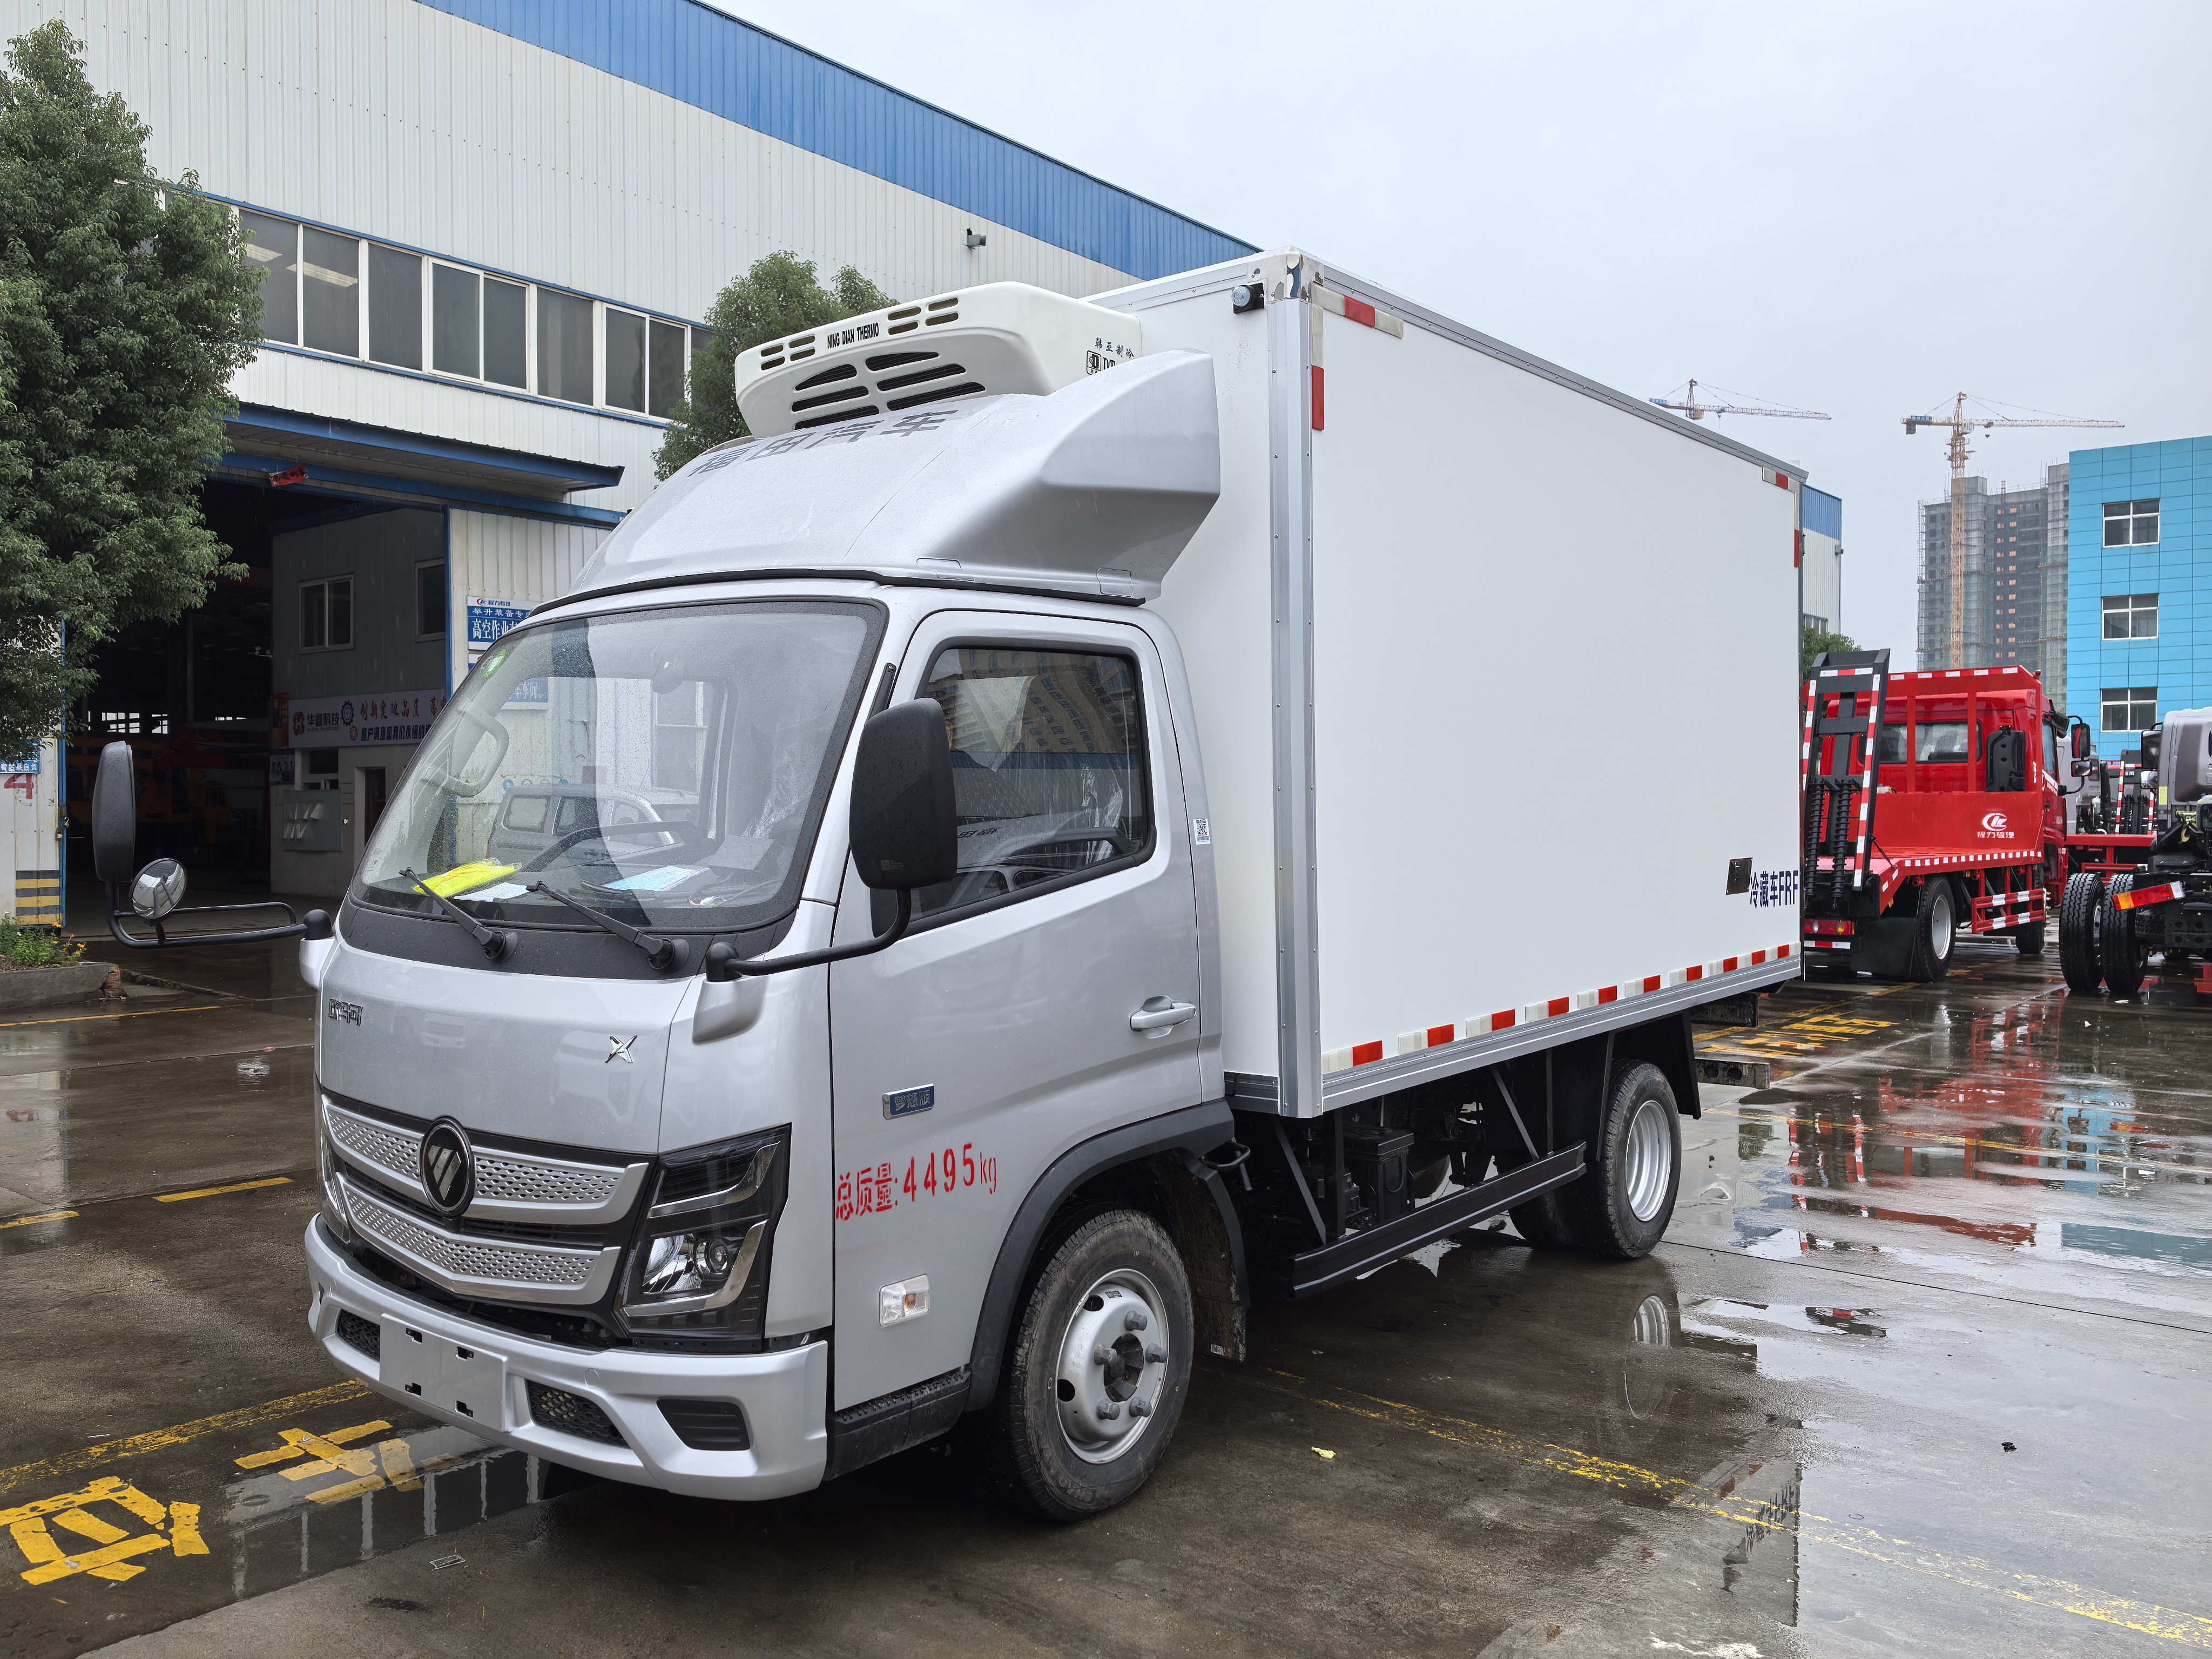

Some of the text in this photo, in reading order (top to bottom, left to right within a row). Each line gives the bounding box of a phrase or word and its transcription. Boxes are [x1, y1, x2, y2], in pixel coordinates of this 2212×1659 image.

[827, 322, 879, 349] NING DIAN THERMO
[1094, 336, 1135, 360] 韩亚制冷
[687, 409, 959, 477] 福田汽车
[472, 618, 517, 640] 高空作业
[4, 774, 34, 800] 4
[895, 1089, 930, 1111] 梦想版
